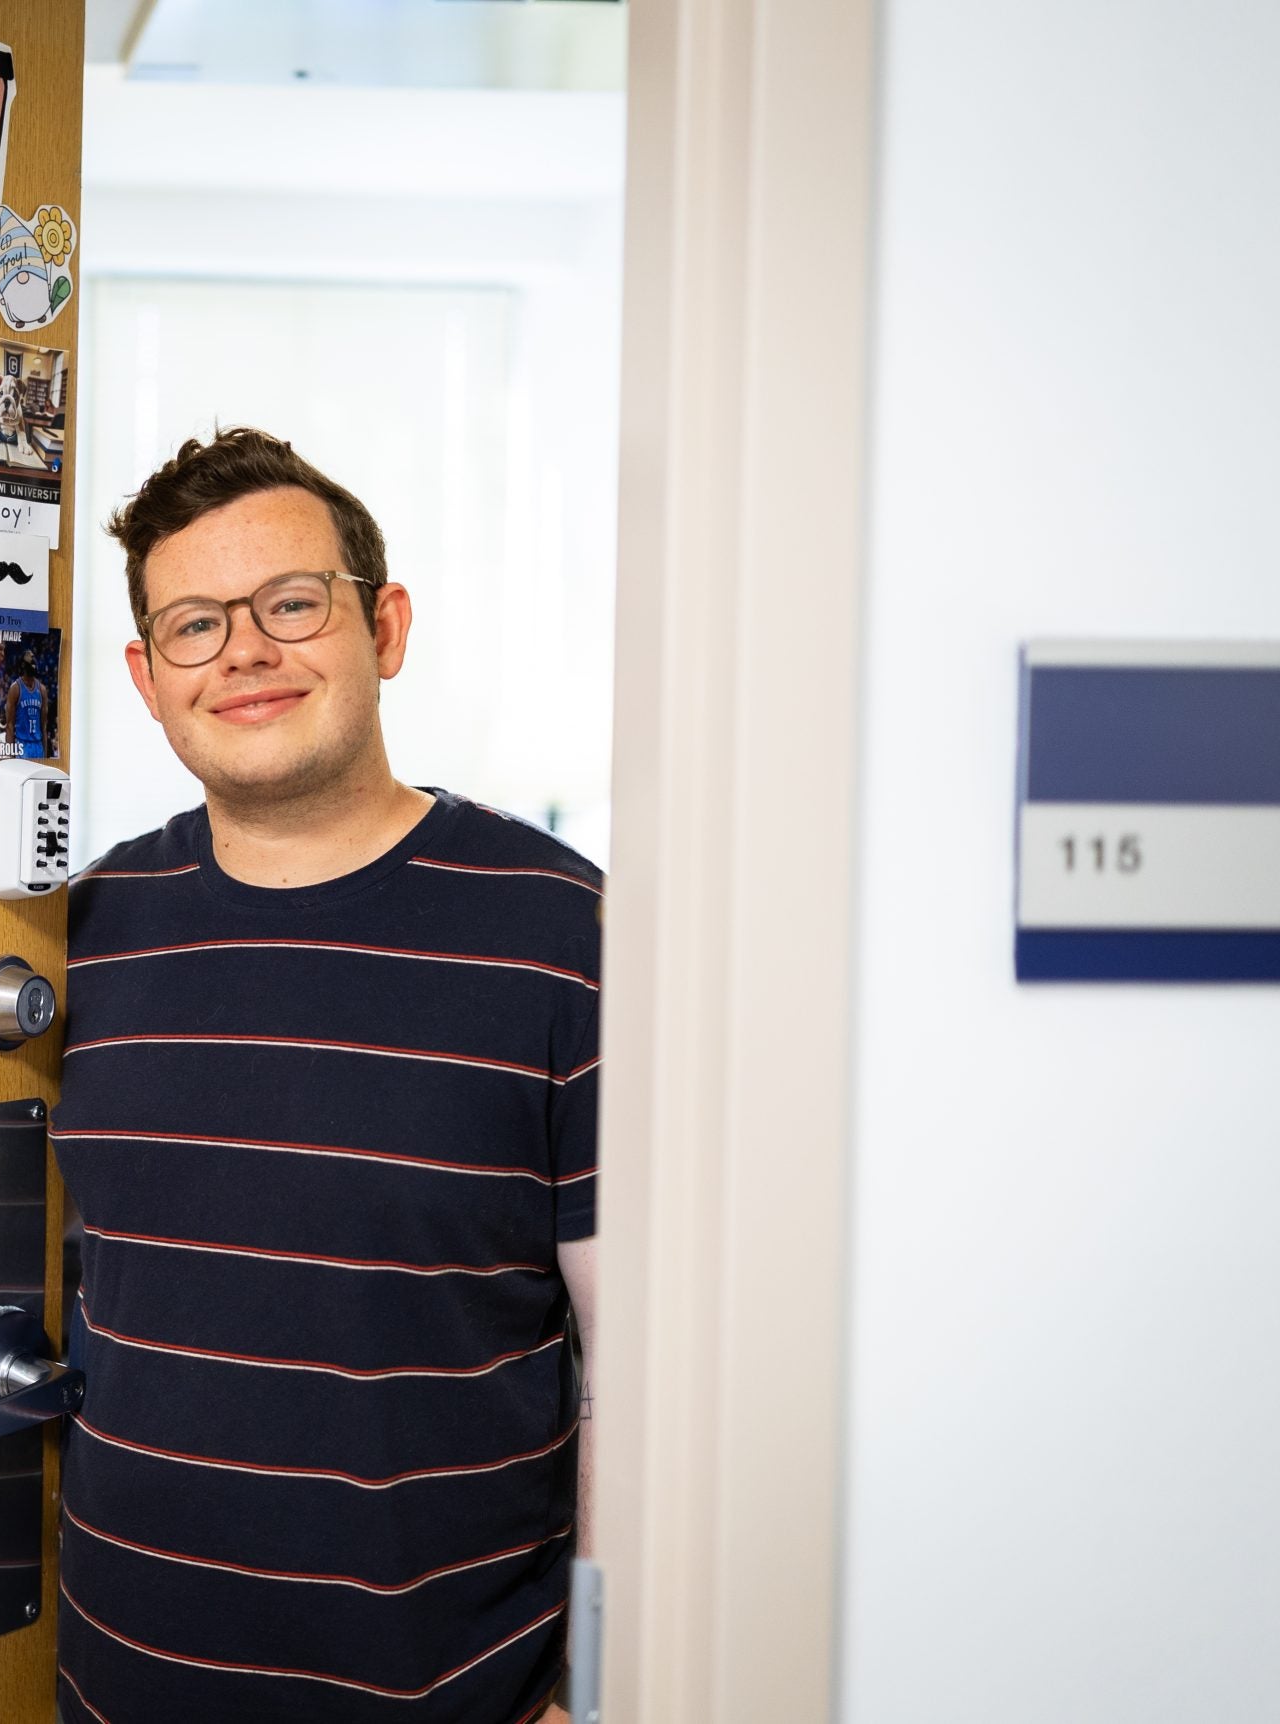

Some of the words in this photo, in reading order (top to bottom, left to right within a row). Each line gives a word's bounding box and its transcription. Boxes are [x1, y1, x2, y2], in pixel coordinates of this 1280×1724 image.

[0, 234, 12, 250] CD
[0, 242, 31, 280] Troy!
[9, 356, 18, 375] G
[7, 616, 22, 627] Troy
[2, 630, 22, 642] MADE
[0, 742, 24, 756] ROLLS
[1059, 833, 1144, 876] 115
